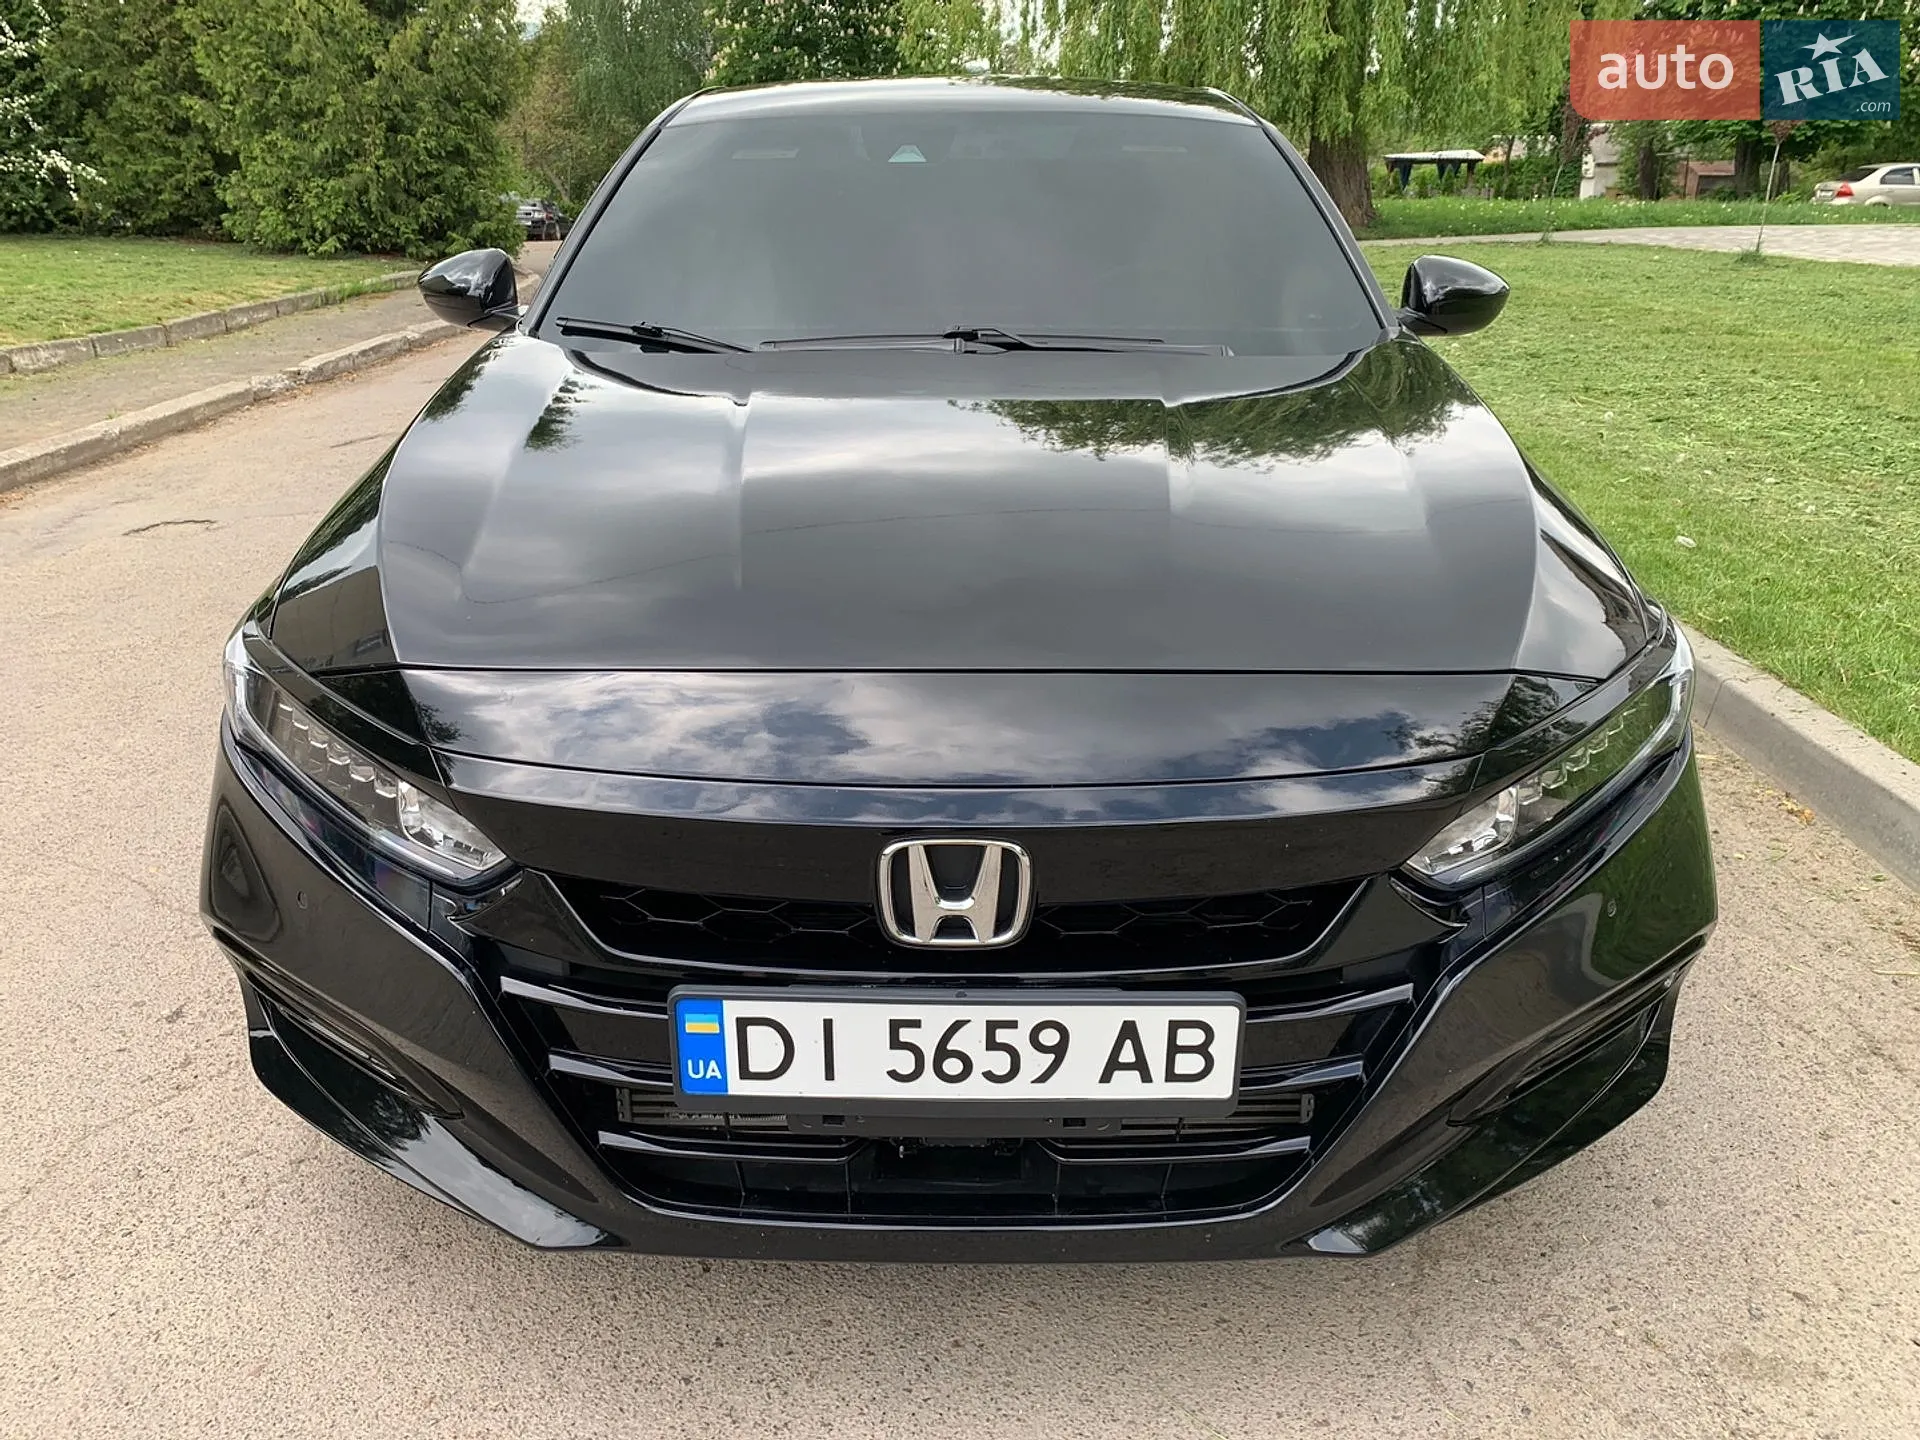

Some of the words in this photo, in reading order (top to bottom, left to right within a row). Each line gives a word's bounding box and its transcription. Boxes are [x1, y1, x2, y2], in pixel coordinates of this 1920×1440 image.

[688, 1060, 722, 1080] UA
[736, 1017, 836, 1081] DI
[886, 1019, 1071, 1084] 5659
[1098, 1020, 1216, 1084] AB
